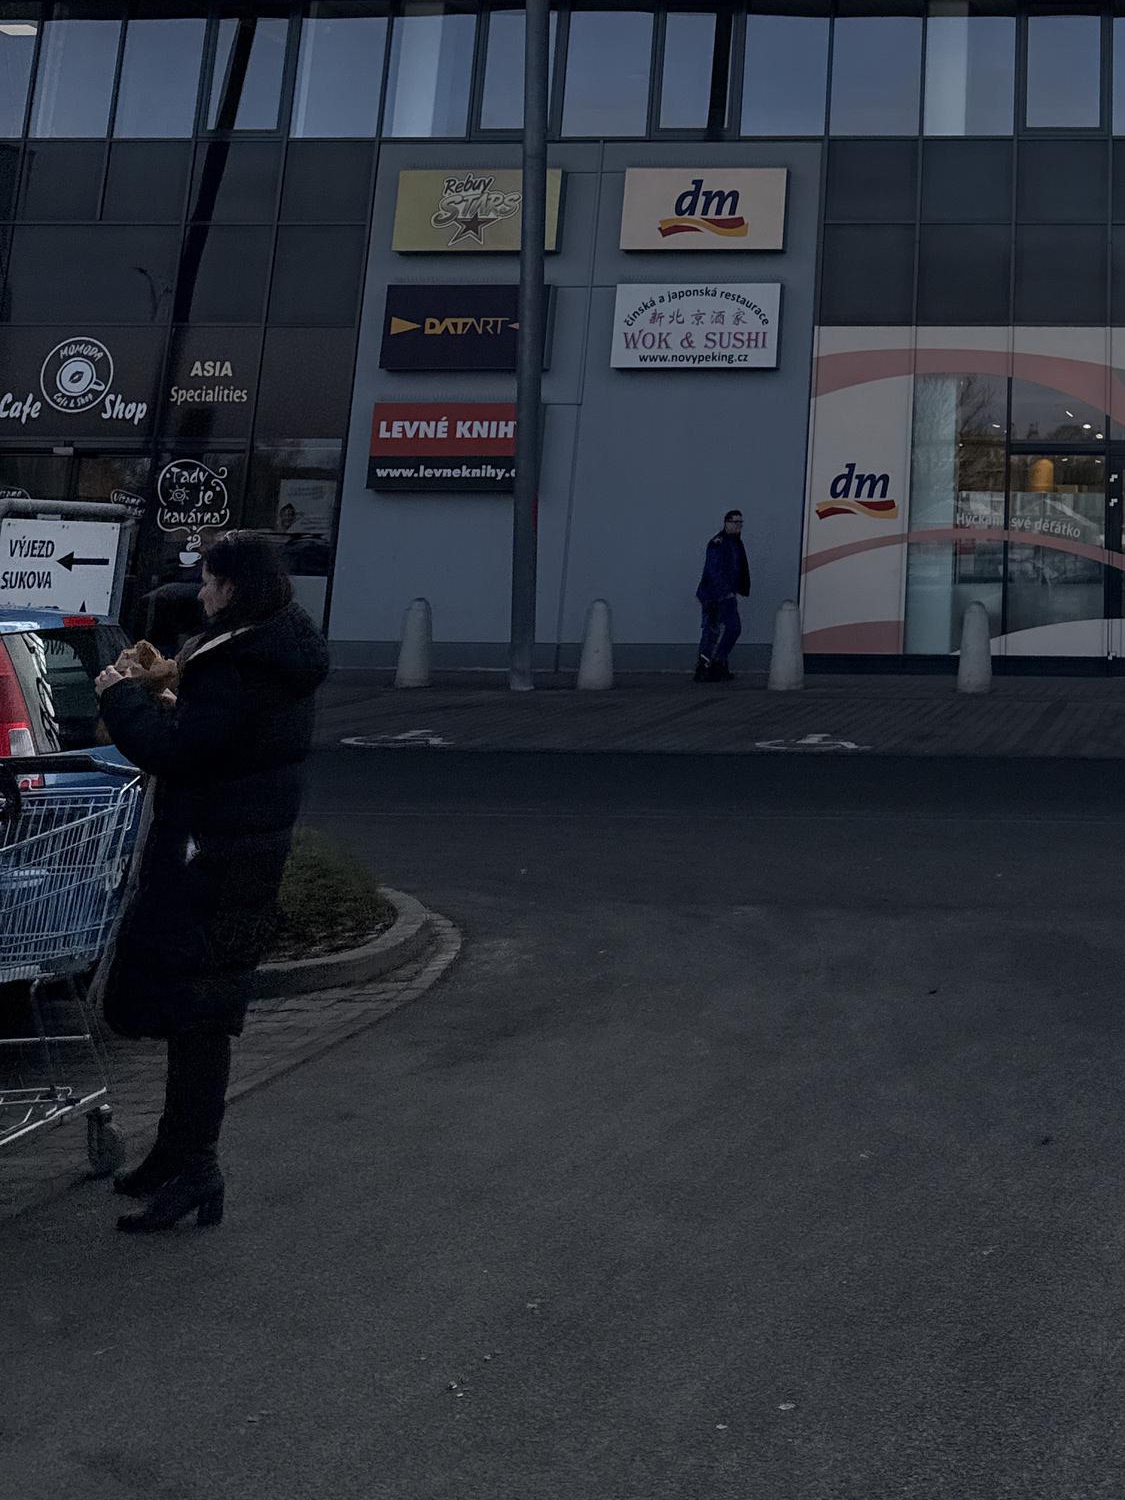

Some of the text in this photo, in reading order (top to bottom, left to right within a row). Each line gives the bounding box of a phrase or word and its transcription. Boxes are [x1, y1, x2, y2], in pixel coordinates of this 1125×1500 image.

[444, 174, 493, 195] Rebuy
[674, 179, 739, 217] dm
[433, 192, 522, 226] STARS
[623, 287, 770, 327] čínská a japonská restaurace
[424, 317, 511, 335] DATART
[623, 329, 768, 350] WOK & SUSHI
[60, 343, 104, 362] MOMODA
[639, 351, 749, 365] www.novypeking.cz
[190, 360, 233, 377] ASIA
[170, 385, 248, 406] Specialities
[0, 392, 147, 426] Cafe Shop
[379, 416, 518, 439] LEVNÉ KNIH
[171, 467, 208, 486] Tady
[830, 463, 890, 499] dm
[195, 486, 214, 507] je
[163, 508, 221, 524] kavárna
[1011, 516, 1031, 530] své
[1034, 517, 1081, 539] děťátko
[10, 535, 55, 558] VÝJEZD
[1, 571, 52, 590] SUKOVA
